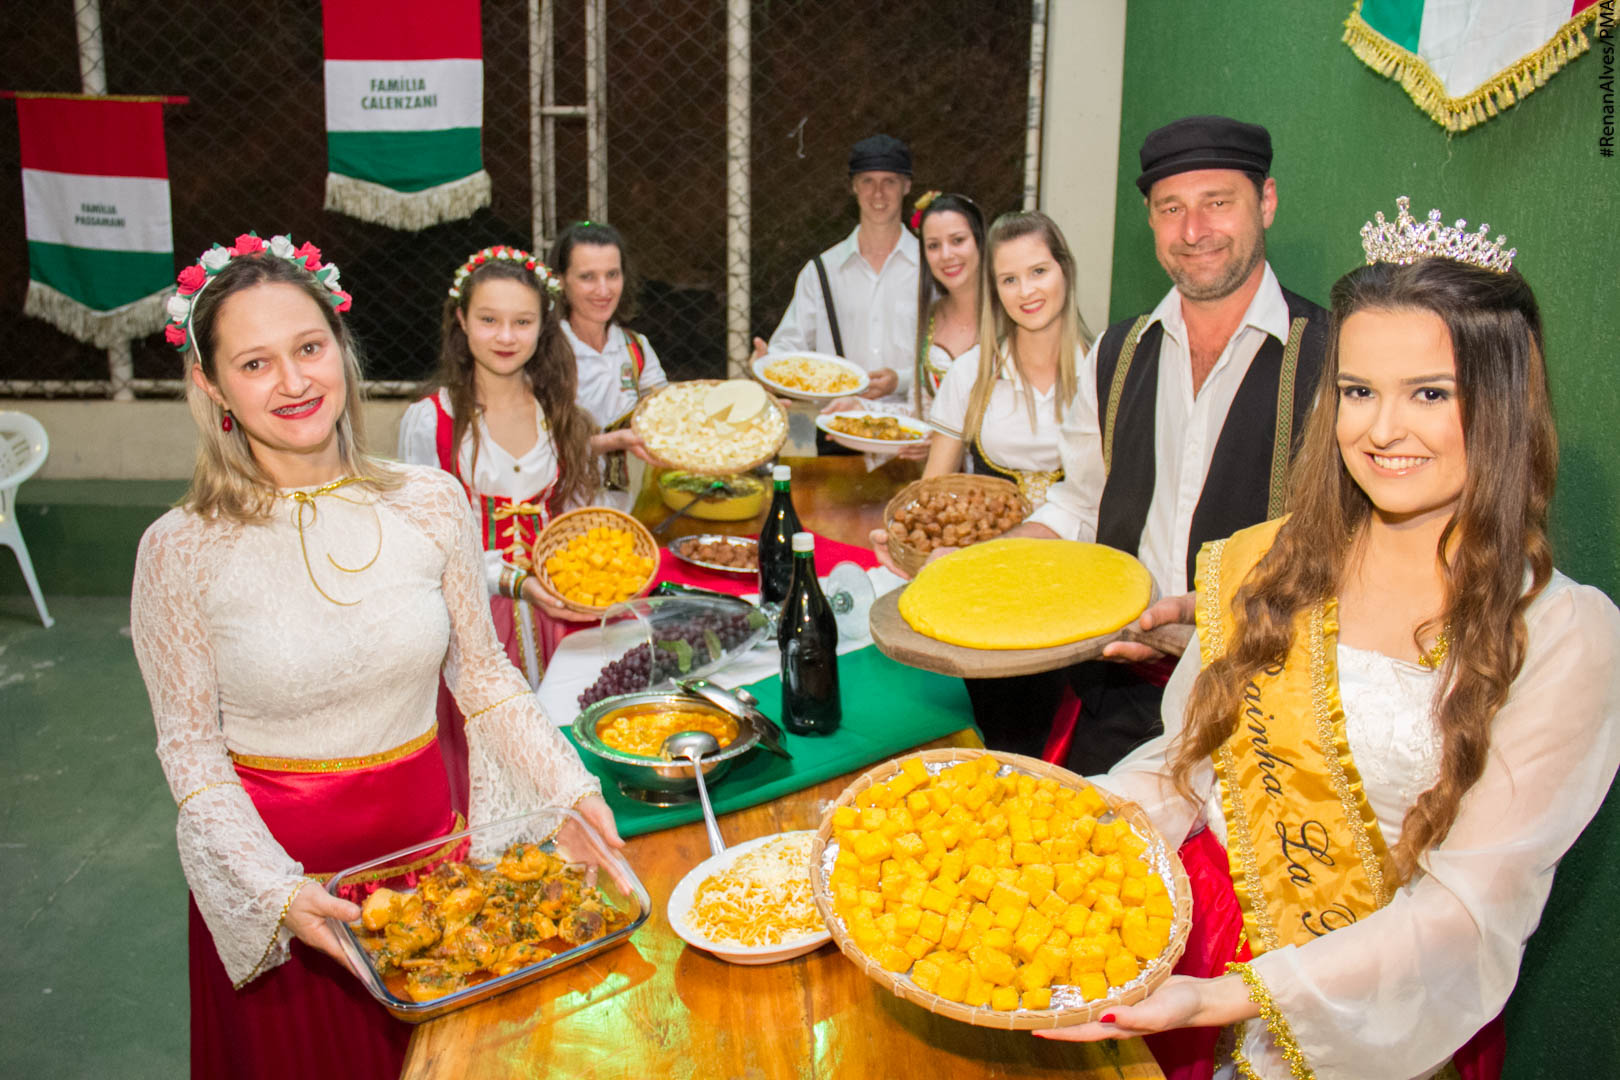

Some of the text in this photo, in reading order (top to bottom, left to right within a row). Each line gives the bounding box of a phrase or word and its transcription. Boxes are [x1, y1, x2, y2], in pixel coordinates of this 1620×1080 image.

[370, 75, 426, 92] FAMÍLIA
[361, 94, 437, 110] CALENZANI
[1275, 820, 1335, 887] La
